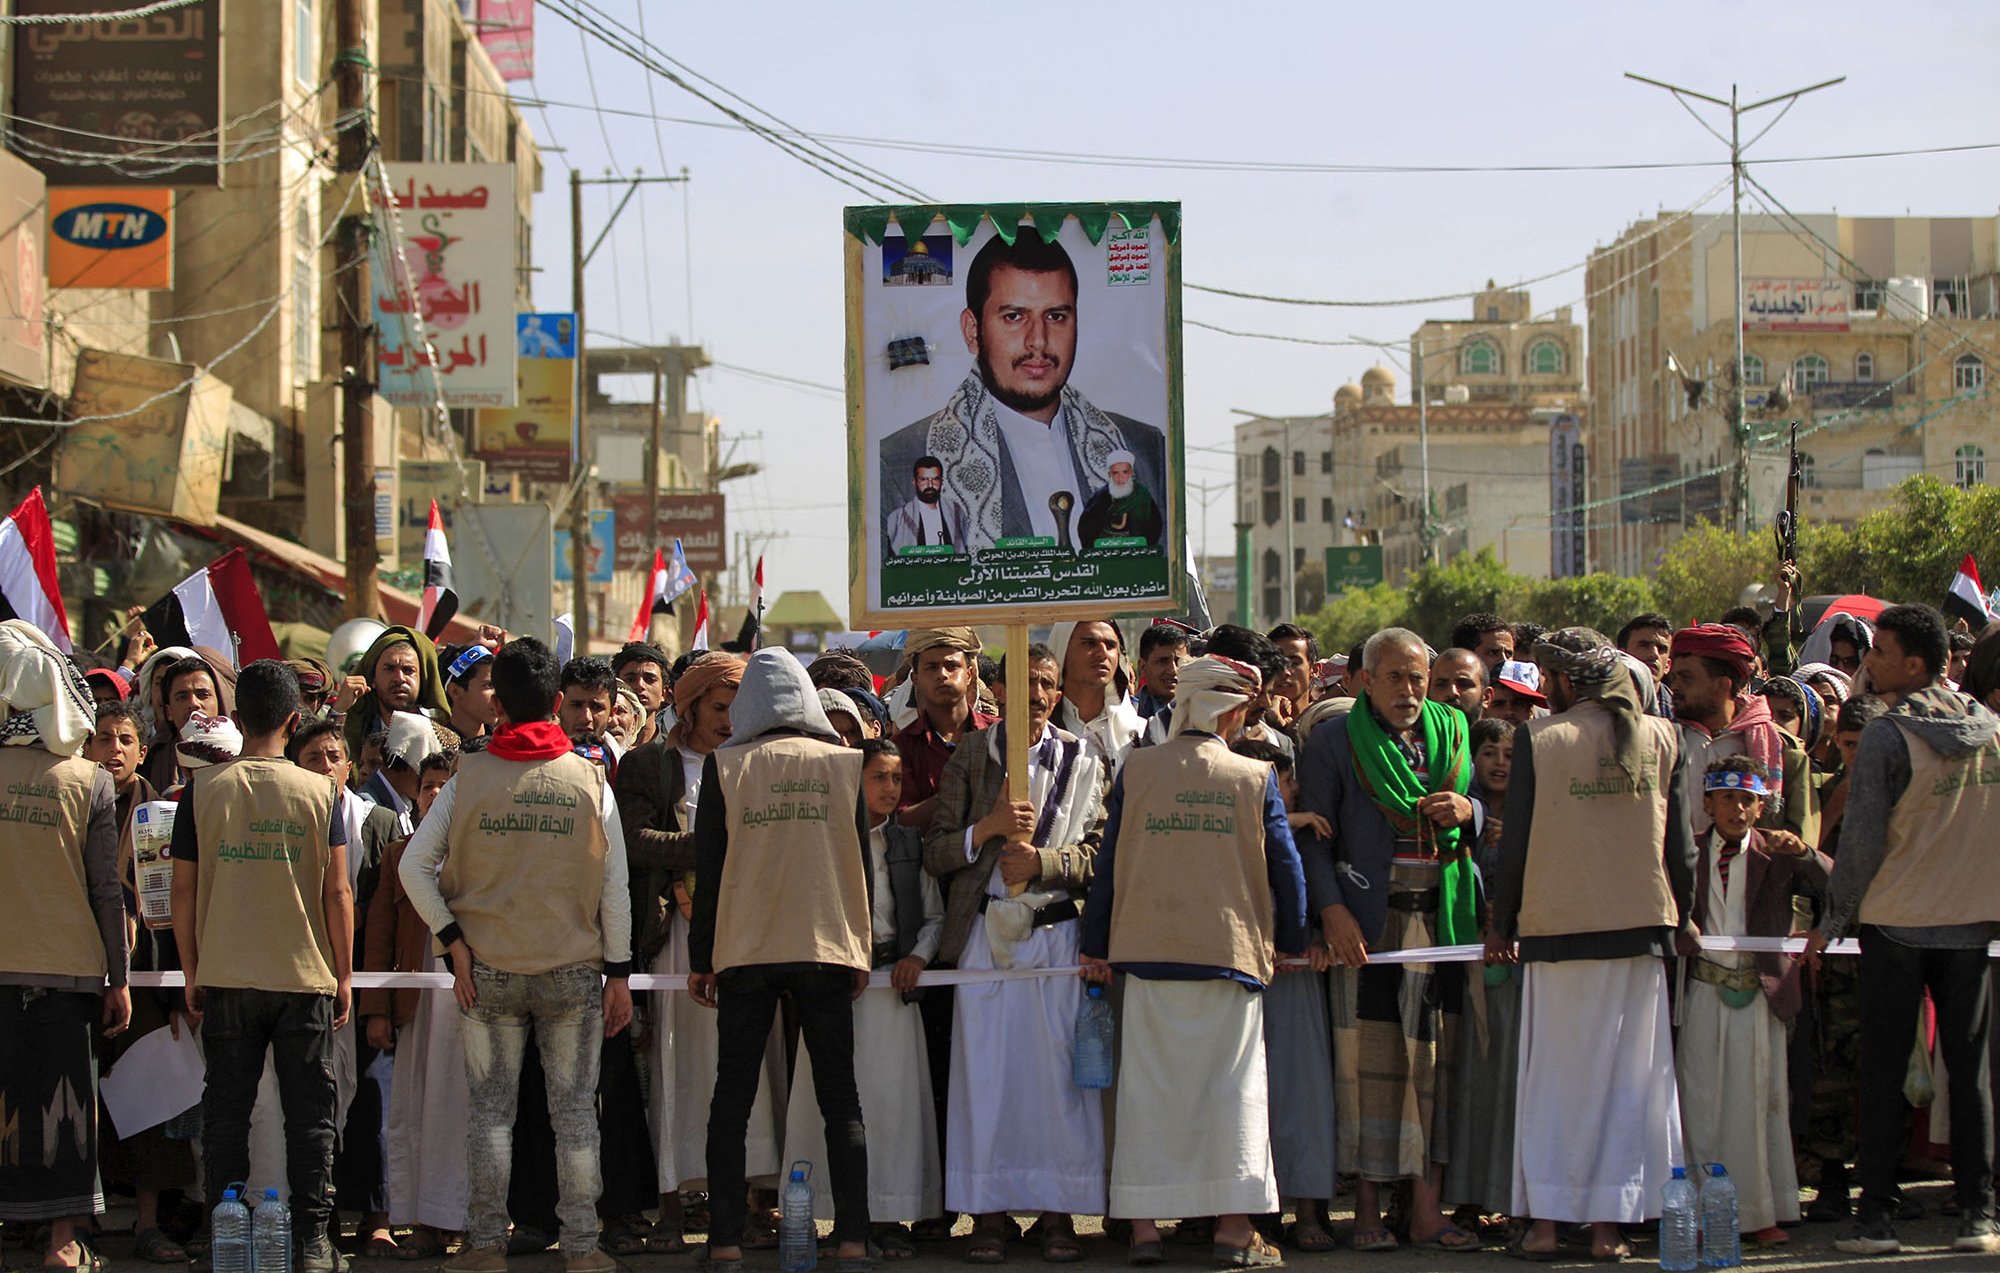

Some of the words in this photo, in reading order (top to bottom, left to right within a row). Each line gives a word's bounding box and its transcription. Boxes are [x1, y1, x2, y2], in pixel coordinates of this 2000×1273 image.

[71, 212, 149, 240] MTN
[379, 282, 480, 322] الجرف
[1748, 294, 1813, 322] الجلدية
[1028, 537, 1049, 547] السيد
[979, 550, 1007, 562] الحوثي
[1001, 564, 1051, 584] قضيتنا
[1052, 563, 1100, 582] القدس
[936, 589, 987, 604] الصهاينة
[987, 589, 1003, 603] من
[1003, 586, 1041, 602] القدس
[1041, 584, 1082, 600] لتحرير
[1083, 582, 1103, 595] الله
[1103, 583, 1130, 598] بعون
[1130, 580, 1166, 597] ماضون
[7, 783, 48, 799] الفعاليات
[770, 779, 811, 798] الفعاليات
[812, 779, 830, 798] لجنة
[1569, 777, 1625, 800] التنظيمية
[513, 789, 556, 808] الفعاليات
[555, 792, 577, 812] لجنة
[1175, 789, 1216, 808] الفعاليات
[1215, 791, 1236, 811] لجنة
[28, 806, 64, 832] اللجنة
[742, 801, 796, 830] التنظيمية
[796, 802, 829, 826] اللجنة
[1145, 811, 1202, 836] التنظيمية
[248, 819, 285, 837] الفعاليات
[286, 819, 308, 840] لجنة
[478, 812, 538, 837] التنظيمية
[539, 814, 575, 839] اللجنة
[1202, 813, 1236, 838] اللجنة
[218, 839, 272, 864] التنظيمية
